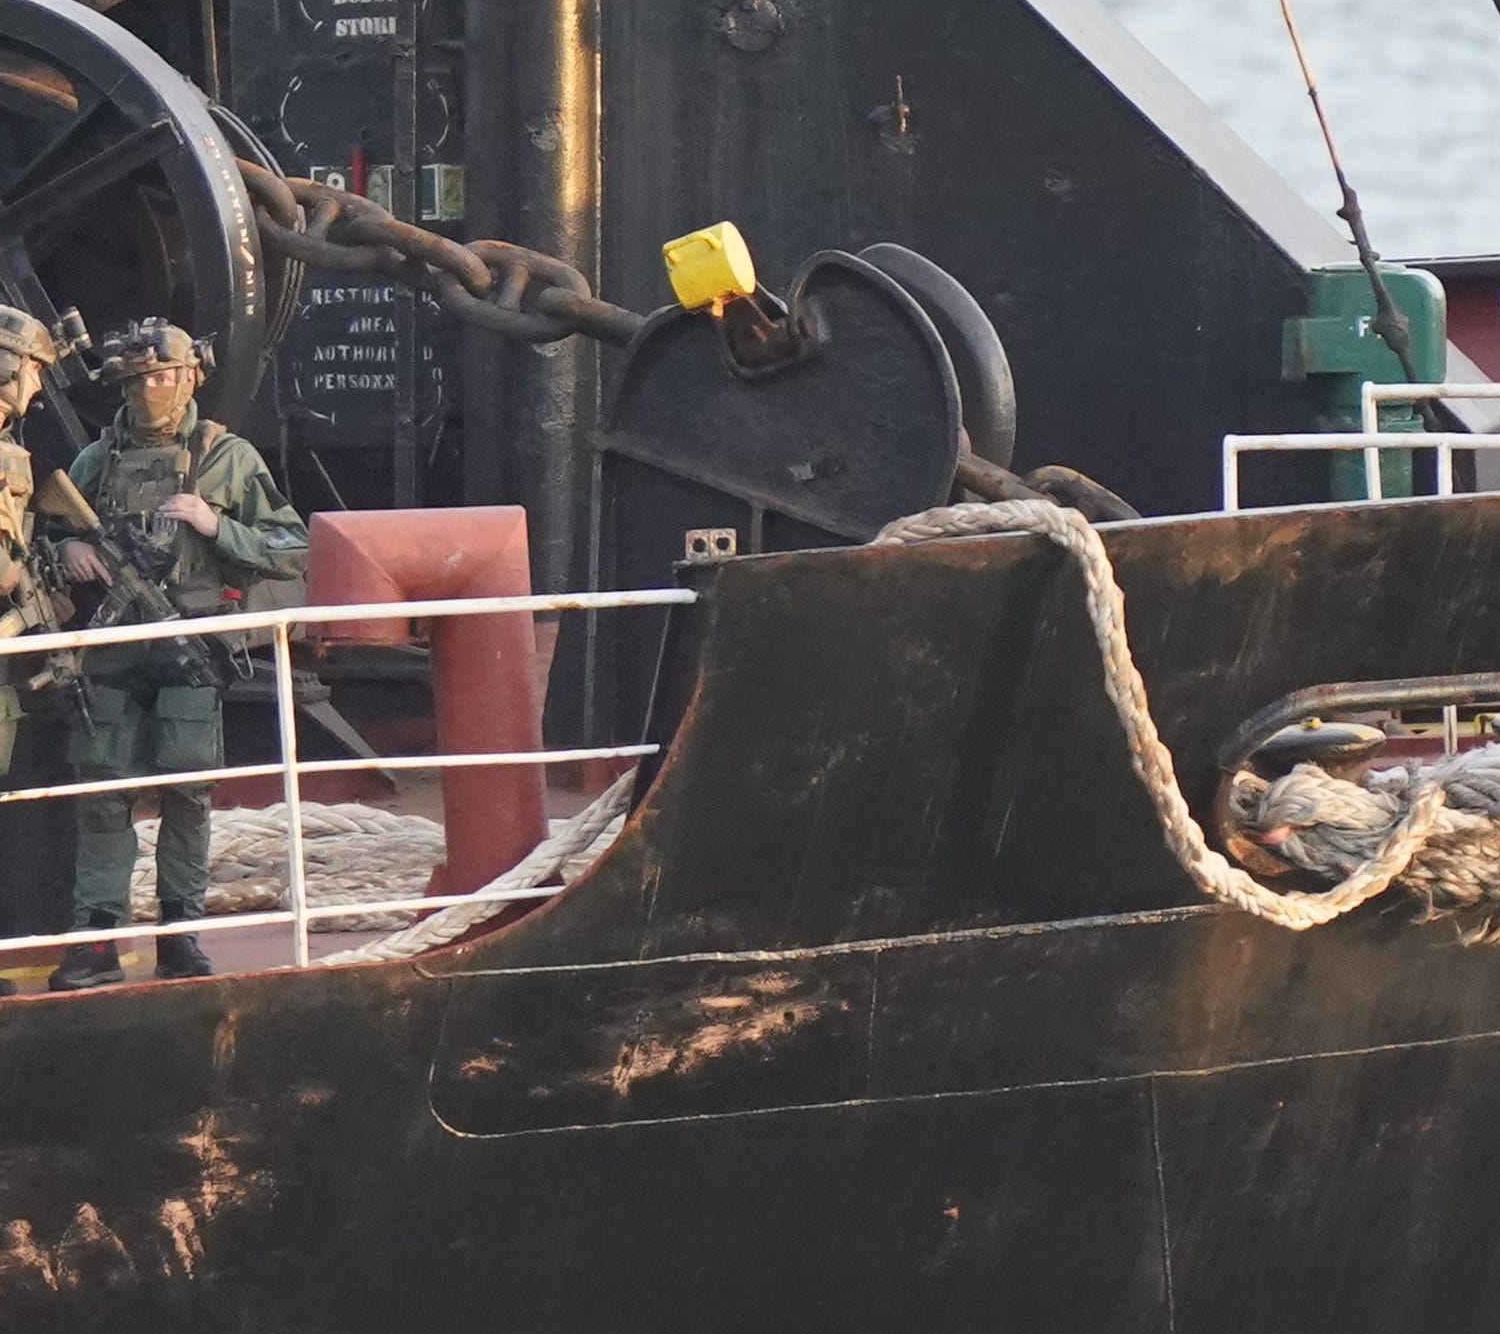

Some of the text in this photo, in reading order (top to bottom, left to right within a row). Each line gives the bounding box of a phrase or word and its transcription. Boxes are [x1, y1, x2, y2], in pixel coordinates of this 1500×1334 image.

[312, 287, 432, 305] RESTRICD
[350, 316, 396, 334] AREA
[313, 344, 432, 362] AUTHORID
